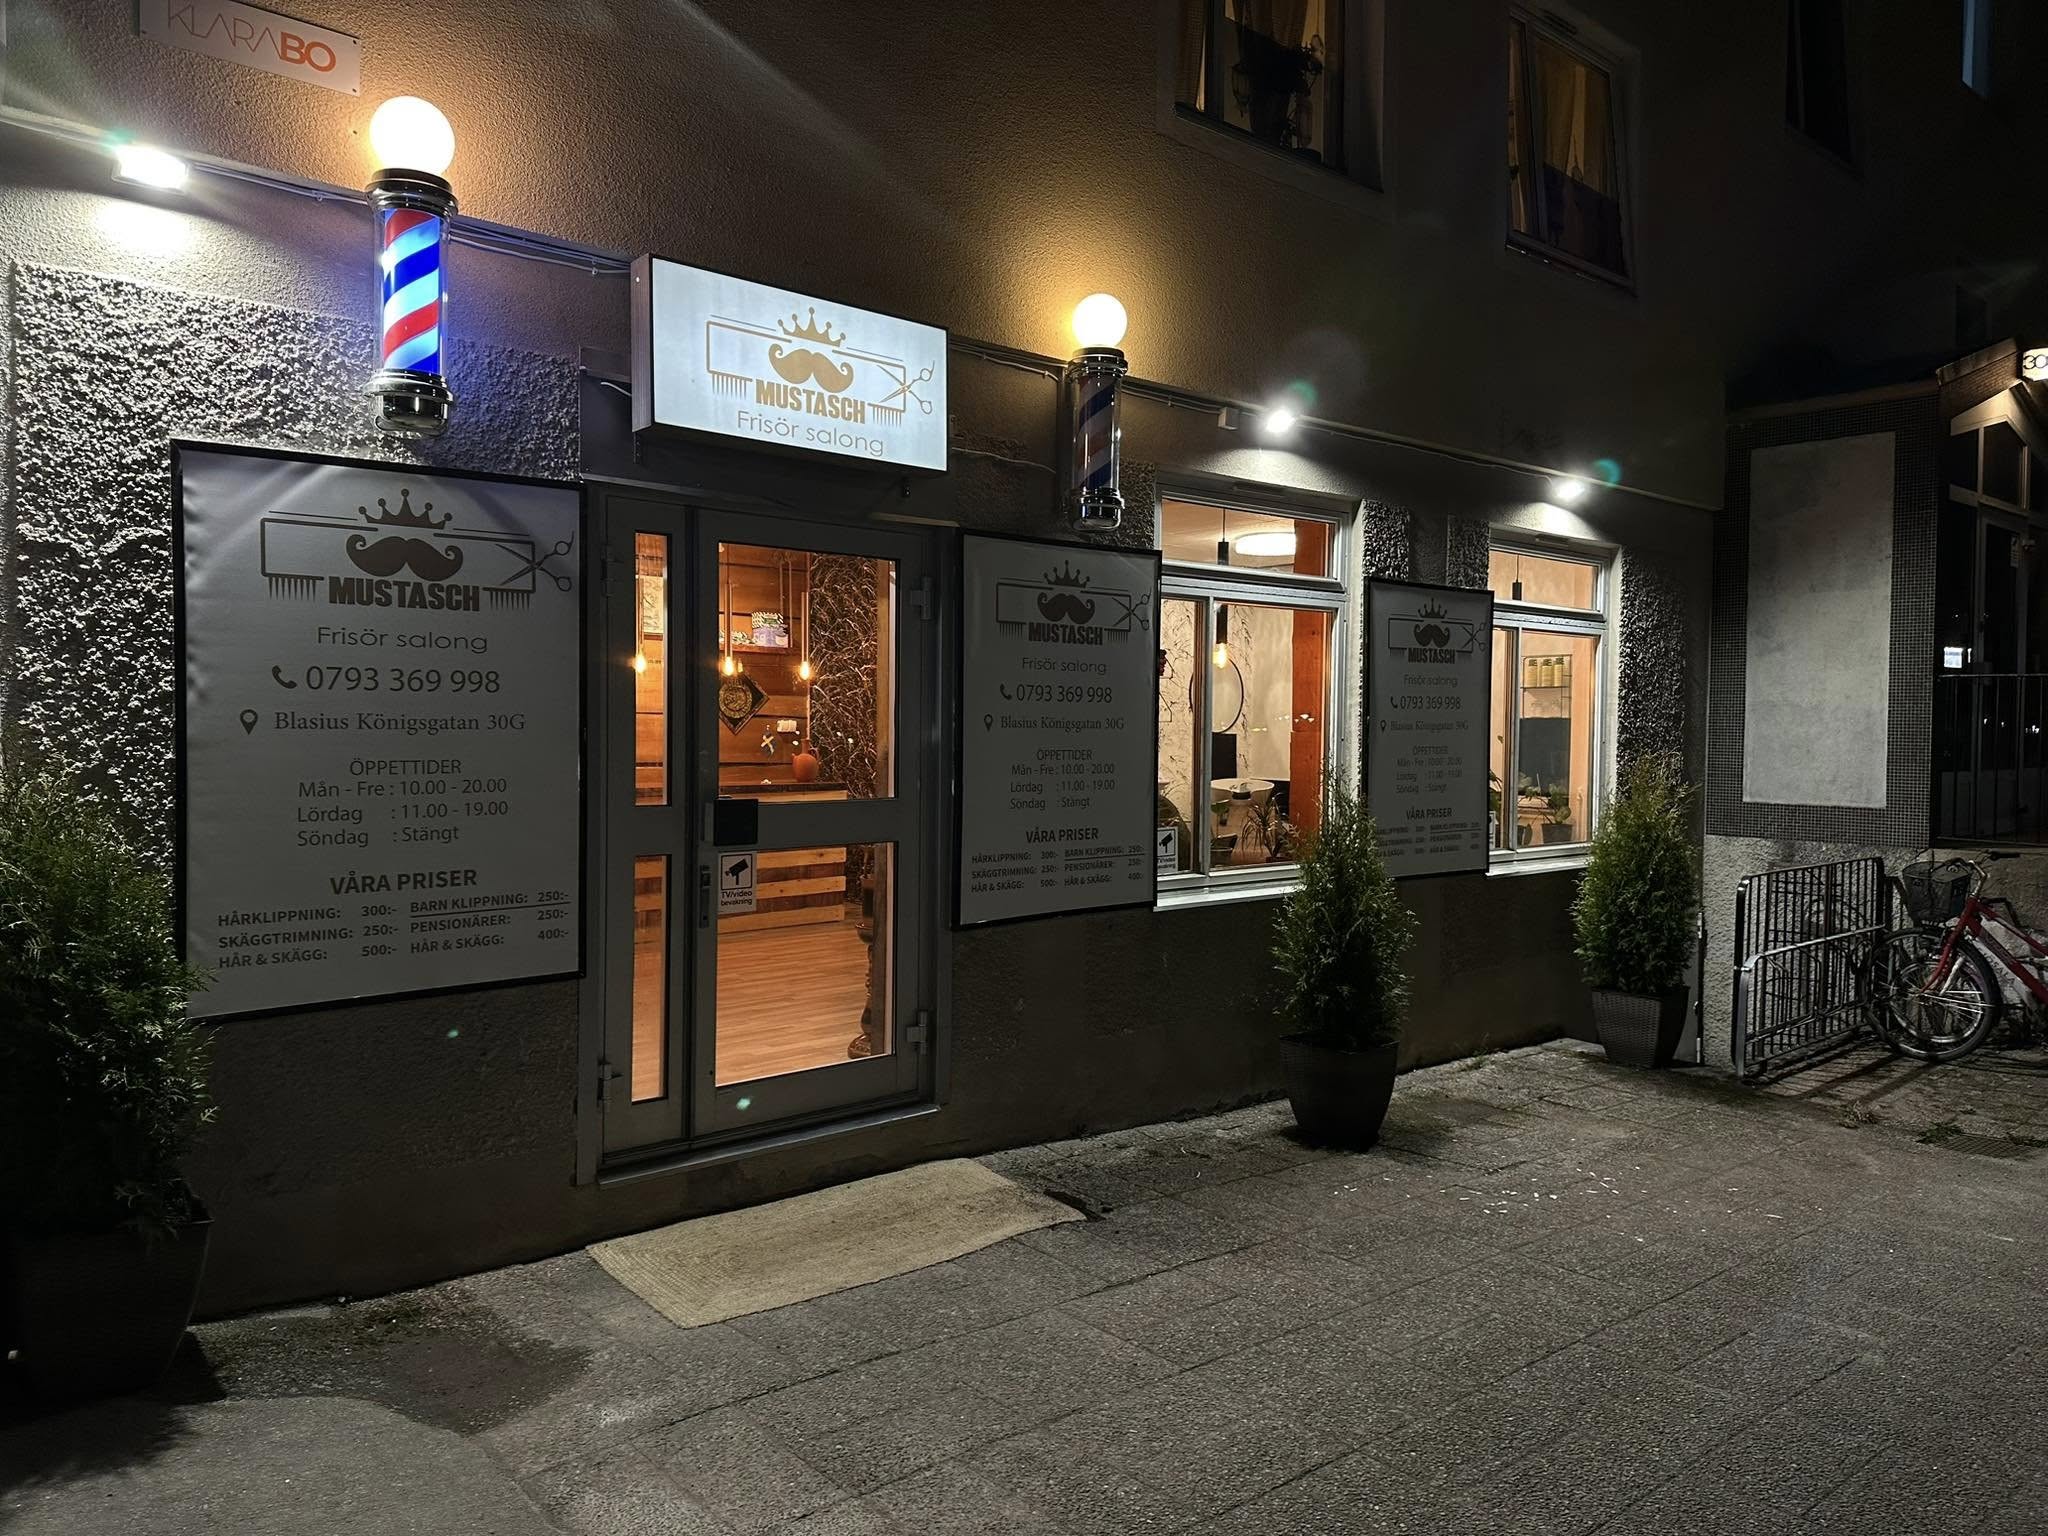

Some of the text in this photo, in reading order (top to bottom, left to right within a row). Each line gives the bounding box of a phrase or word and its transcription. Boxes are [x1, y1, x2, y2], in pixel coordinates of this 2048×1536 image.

[168, 0, 336, 72] KLARABO
[755, 378, 866, 424] MUSTASCH
[737, 410, 884, 457] Frisör salong
[329, 577, 480, 611] MUSTASCH
[318, 626, 488, 653] Frisör salong
[1028, 622, 1103, 646] MUSTASCH
[1022, 657, 1107, 676] Frisör salong
[1408, 647, 1455, 664] MUSTASCH
[306, 666, 500, 693] 0793 369 998
[1016, 684, 1112, 703] 0793 369 998
[1400, 695, 1423, 709] 0793
[1426, 695, 1443, 709] 369
[275, 712, 526, 735] Blasius Königsgatan 30G
[1001, 715, 1125, 733] Blasius Königsgatan 30G
[349, 757, 461, 776] ÖPPETTIDER
[299, 780, 339, 798] Mån
[357, 781, 385, 797] Fre
[399, 780, 448, 796] 10.00
[461, 778, 507, 794] 20.00
[297, 805, 362, 824] Lördag
[402, 803, 448, 819] 11.00
[465, 801, 508, 816] 19.00
[1406, 806, 1453, 820] VÅRA PRISER
[297, 829, 369, 848] Söndag
[402, 826, 459, 845] Stängt
[1026, 827, 1099, 843] VÅRA PRISER
[330, 869, 477, 895] VÅRA PRISER
[218, 906, 341, 927] HÅRKLIPPNING:
[410, 899, 448, 913] BARN
[451, 892, 528, 910] KLIPPNING:
[218, 927, 353, 948] SKÄGGTRIMNING:
[410, 914, 511, 933] PENSIONÄRER:
[219, 953, 252, 969] HÅR
[256, 953, 268, 966] &
[271, 946, 327, 964] SKÄGG:
[410, 939, 438, 954] HÅR
[455, 932, 504, 947] SKÄGG:
